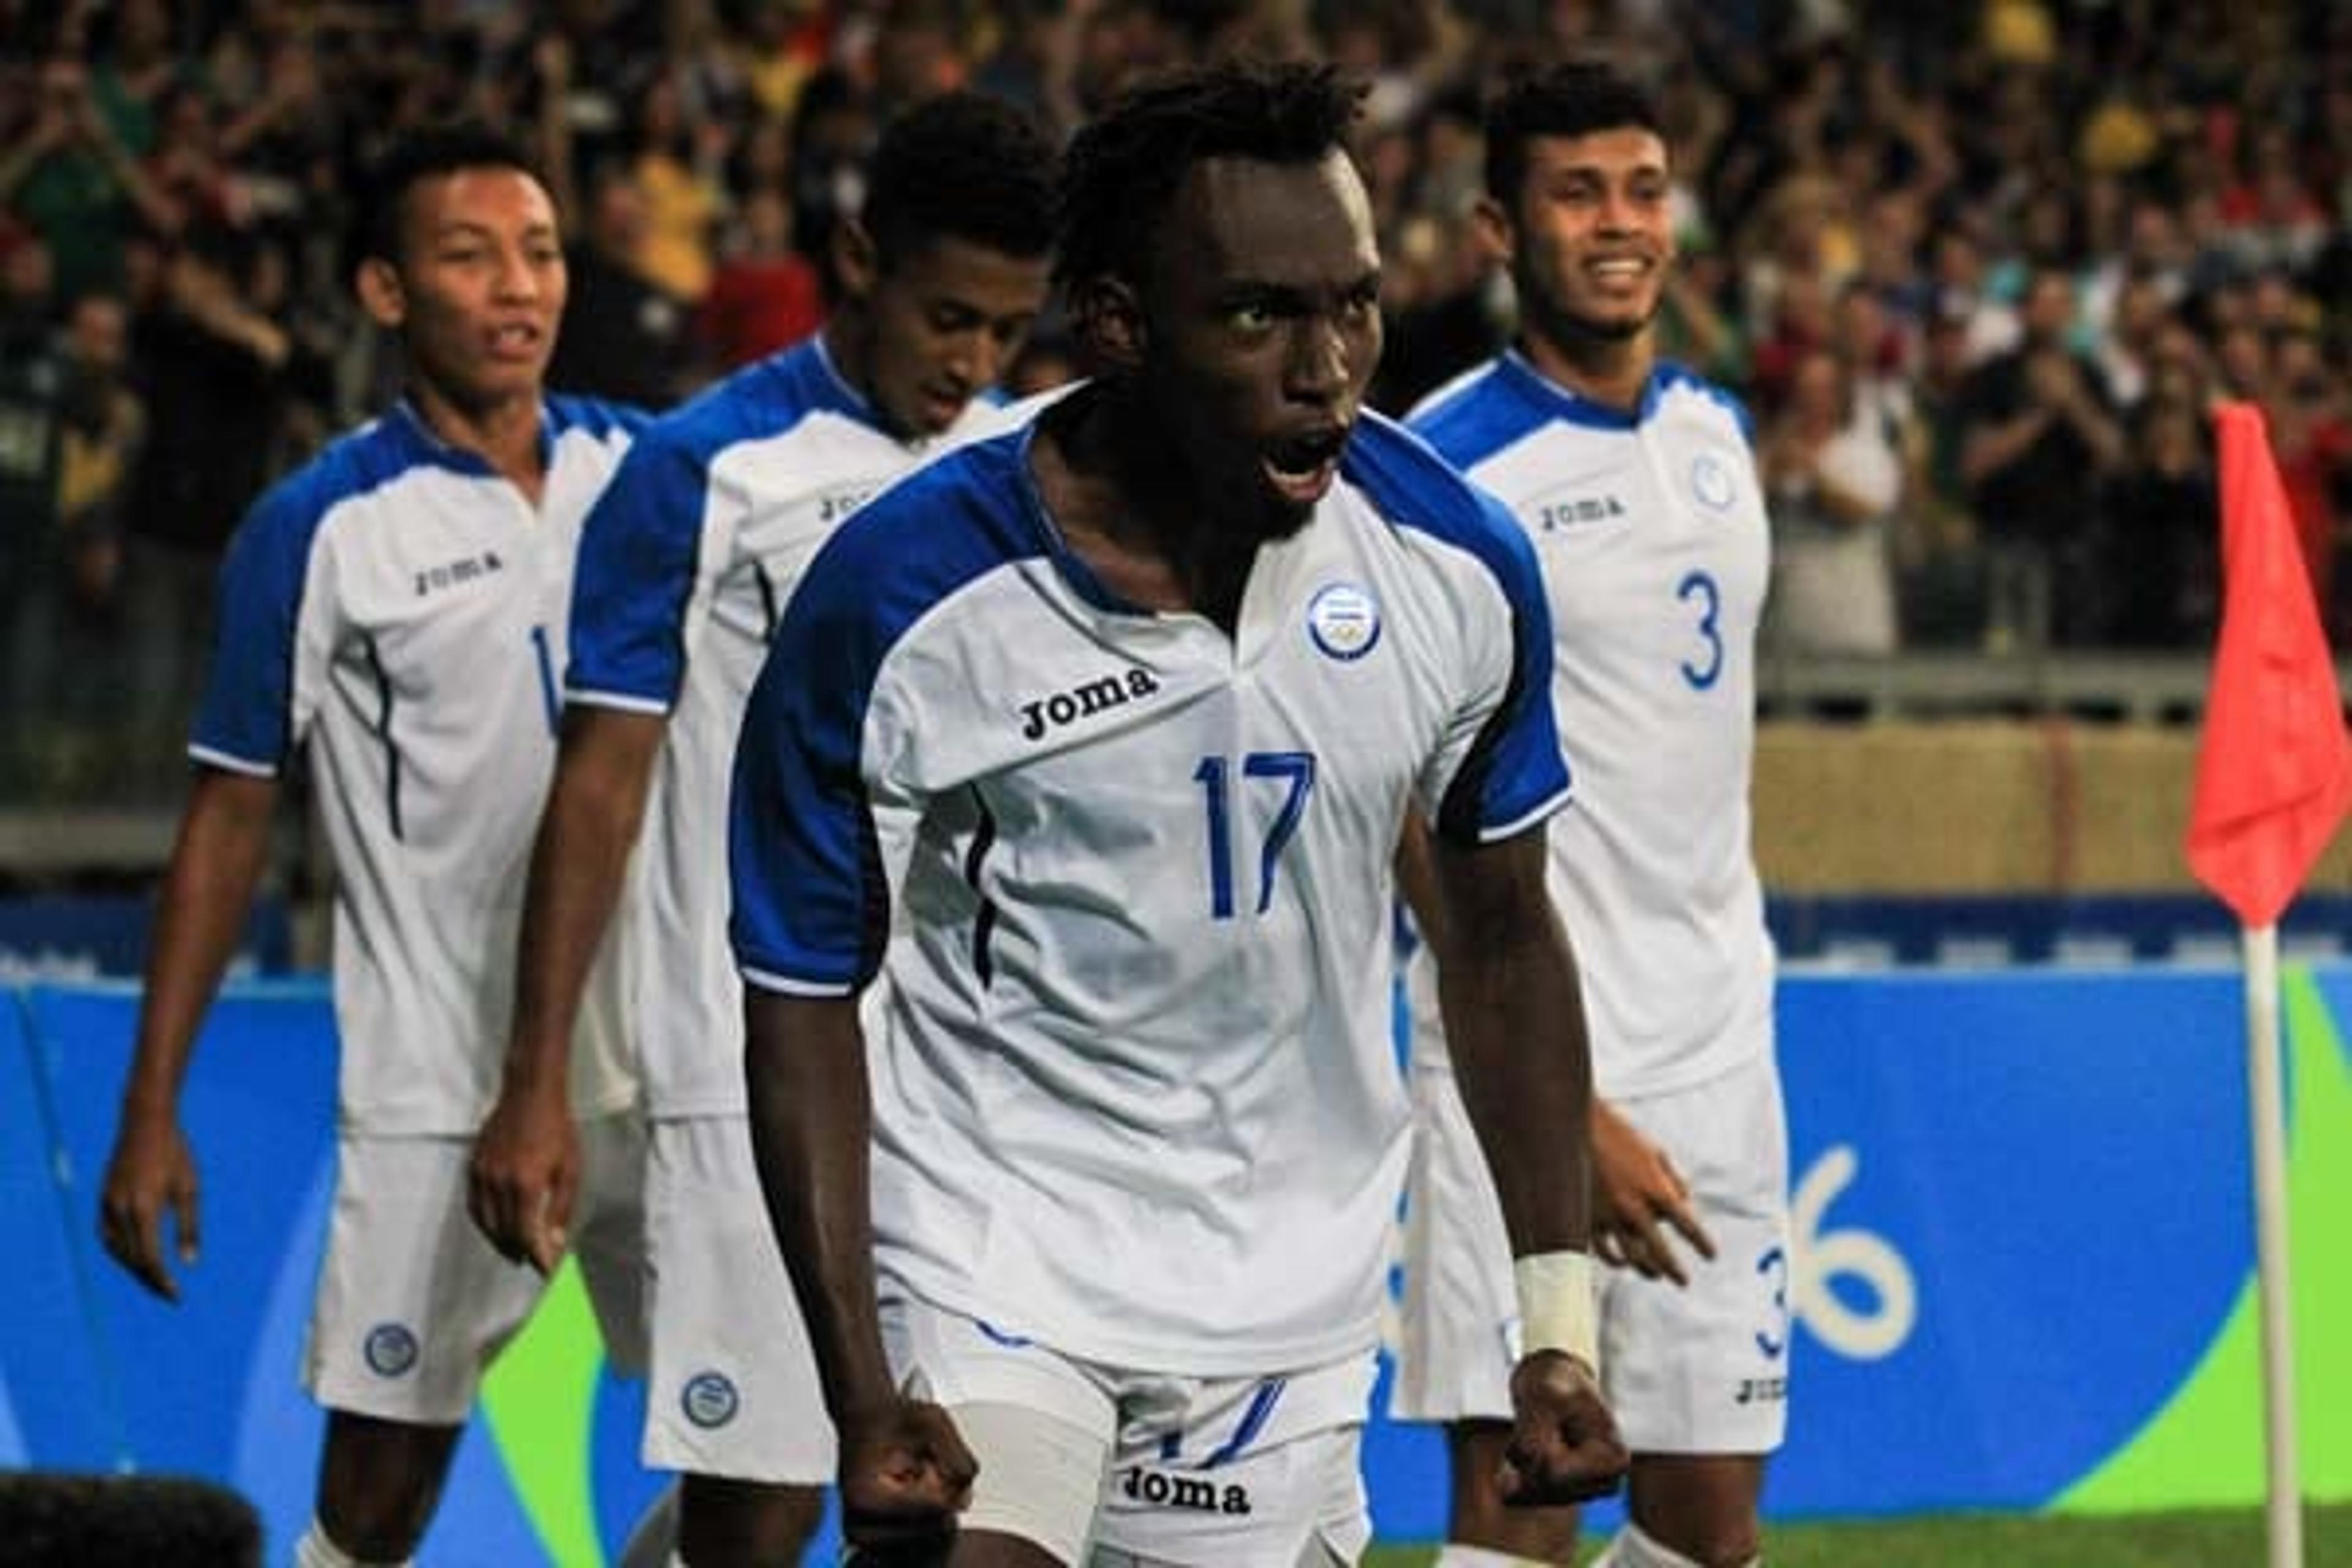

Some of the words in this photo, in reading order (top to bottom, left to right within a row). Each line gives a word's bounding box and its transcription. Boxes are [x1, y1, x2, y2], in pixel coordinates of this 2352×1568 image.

[1677, 570, 1723, 690] 3
[1020, 669, 1159, 740] Joma
[1194, 752, 1316, 919] 17
[1756, 1247, 1787, 1360] 3
[1160, 1378, 1286, 1471] 7
